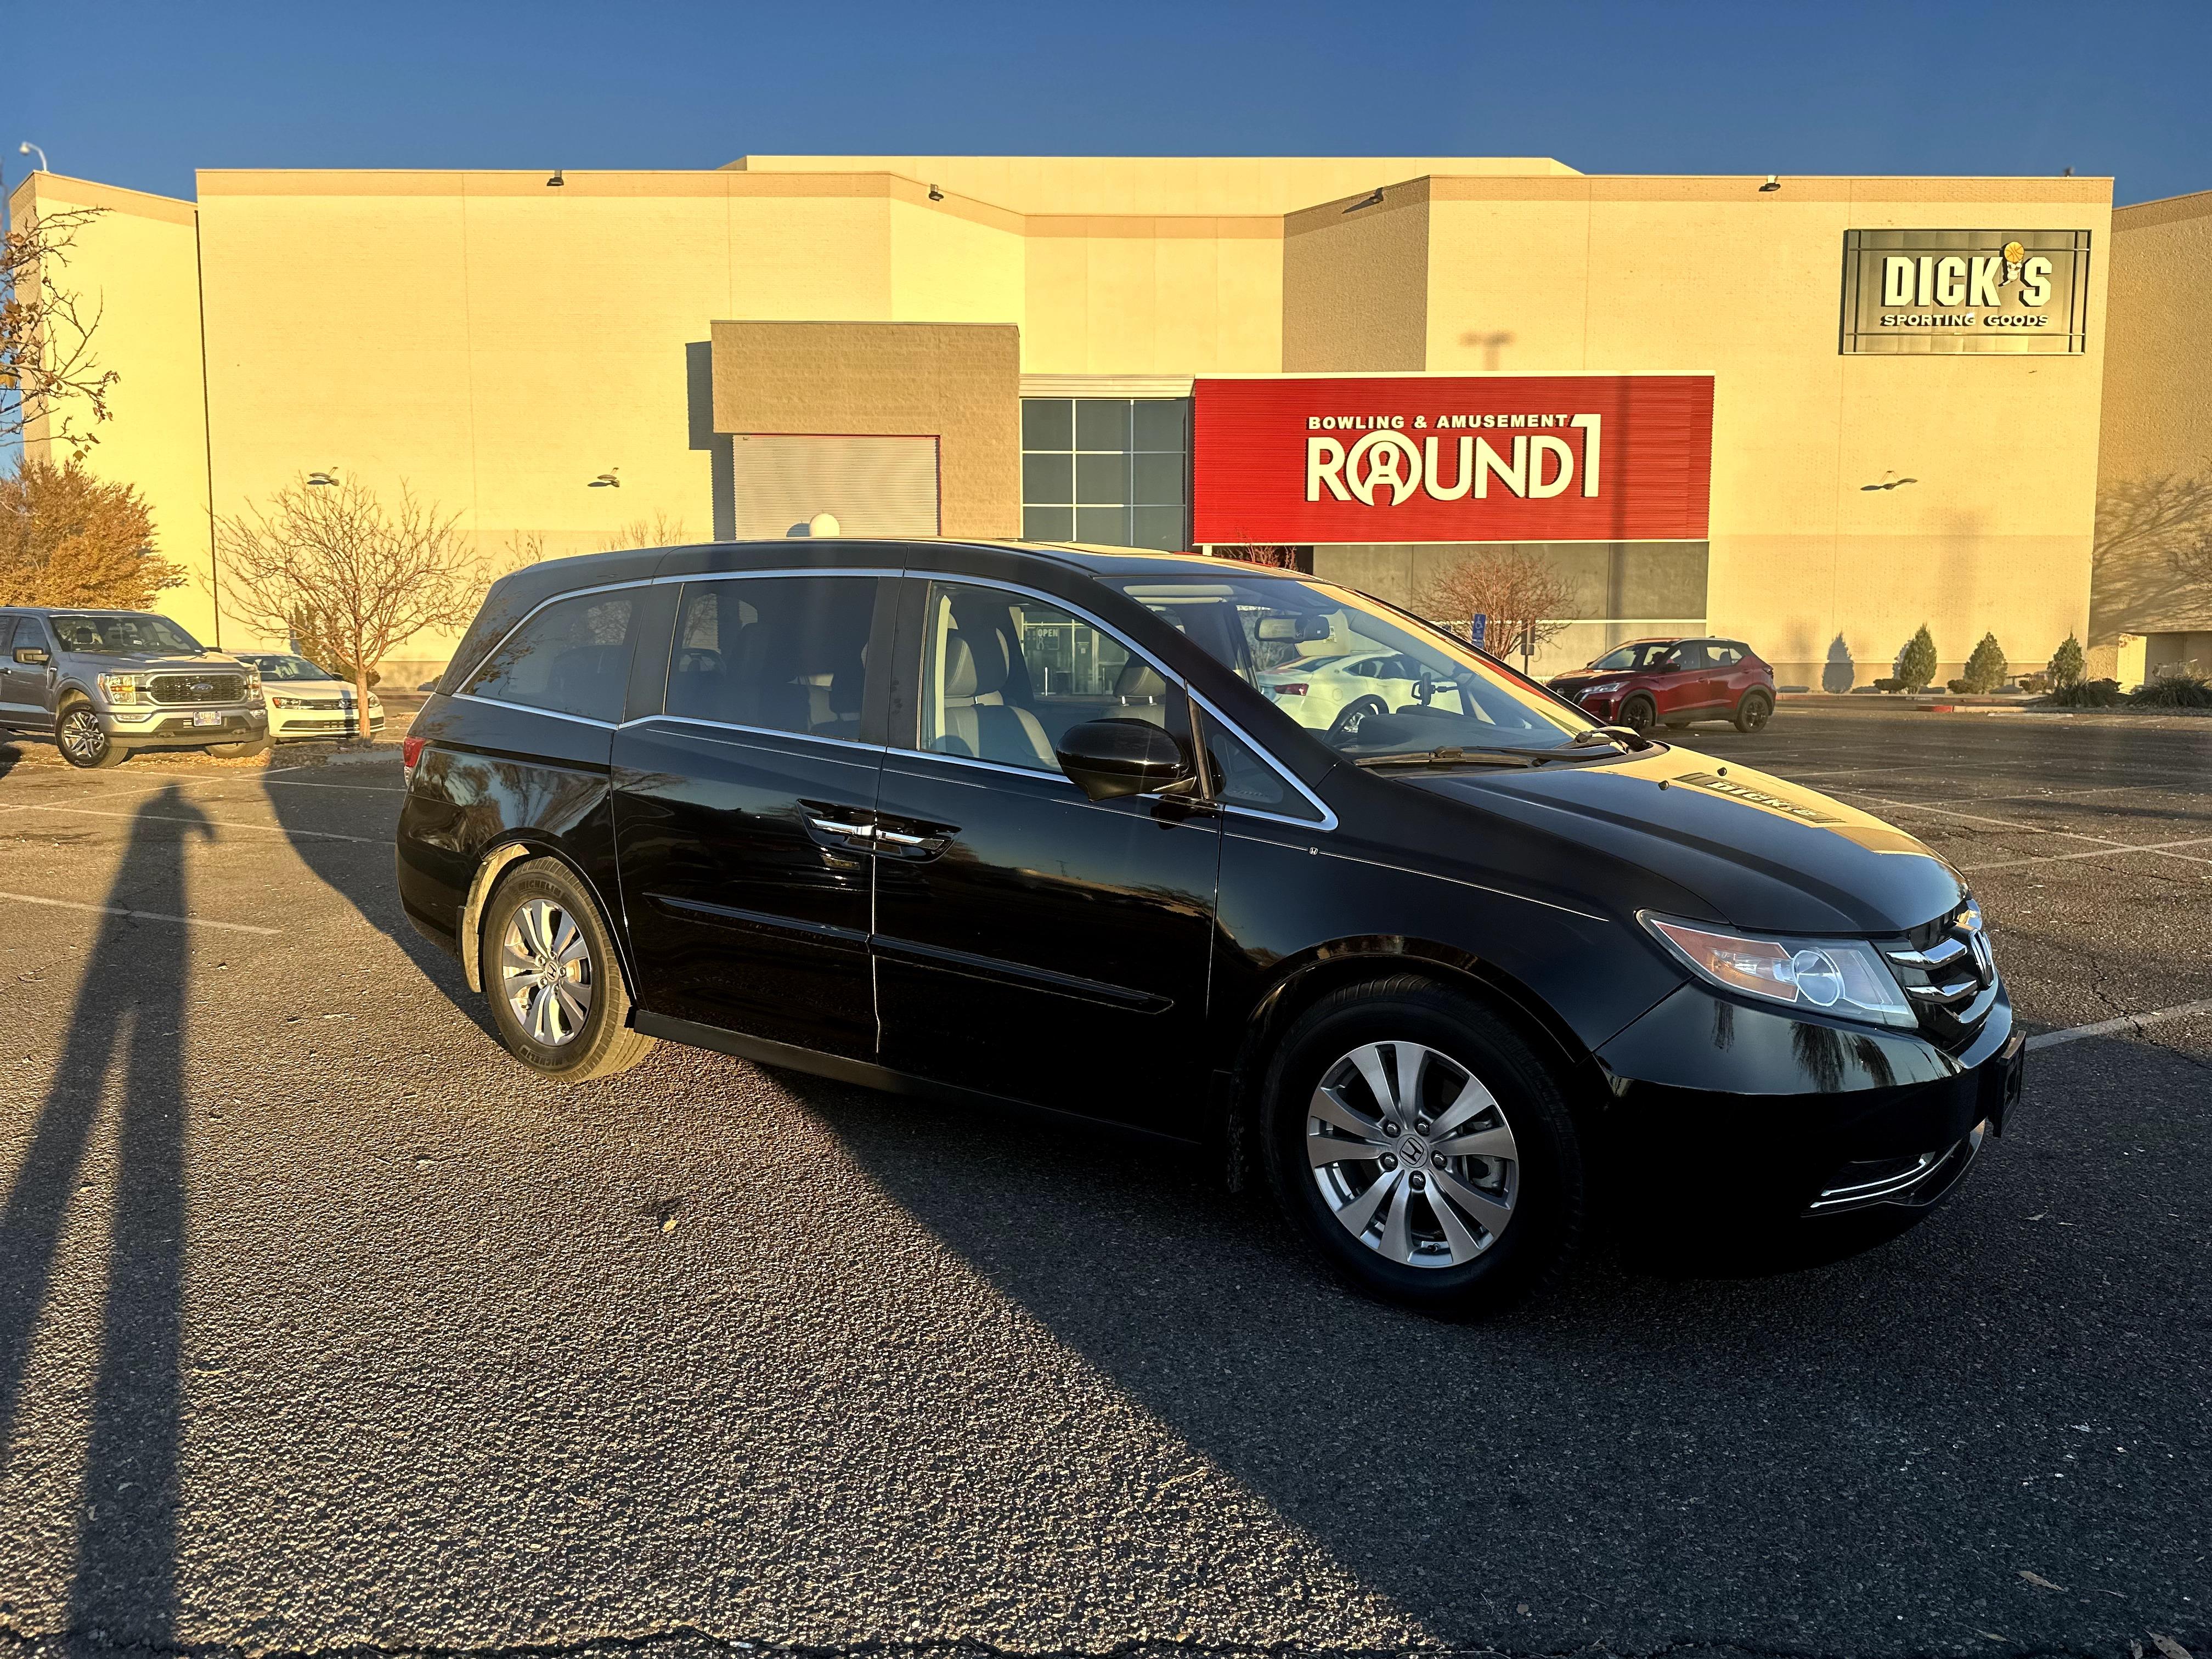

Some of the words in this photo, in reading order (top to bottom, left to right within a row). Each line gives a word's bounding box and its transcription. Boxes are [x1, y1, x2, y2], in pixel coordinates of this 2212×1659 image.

[1884, 256, 2052, 307] DICK'S
[1884, 314, 1976, 326] SPORTING
[1987, 314, 2050, 326] GOODS
[1308, 415, 1405, 430] BOWLING
[1414, 415, 1428, 429] &
[1436, 414, 1568, 429] AMUSEMENT
[1037, 629, 1058, 637] OPEN
